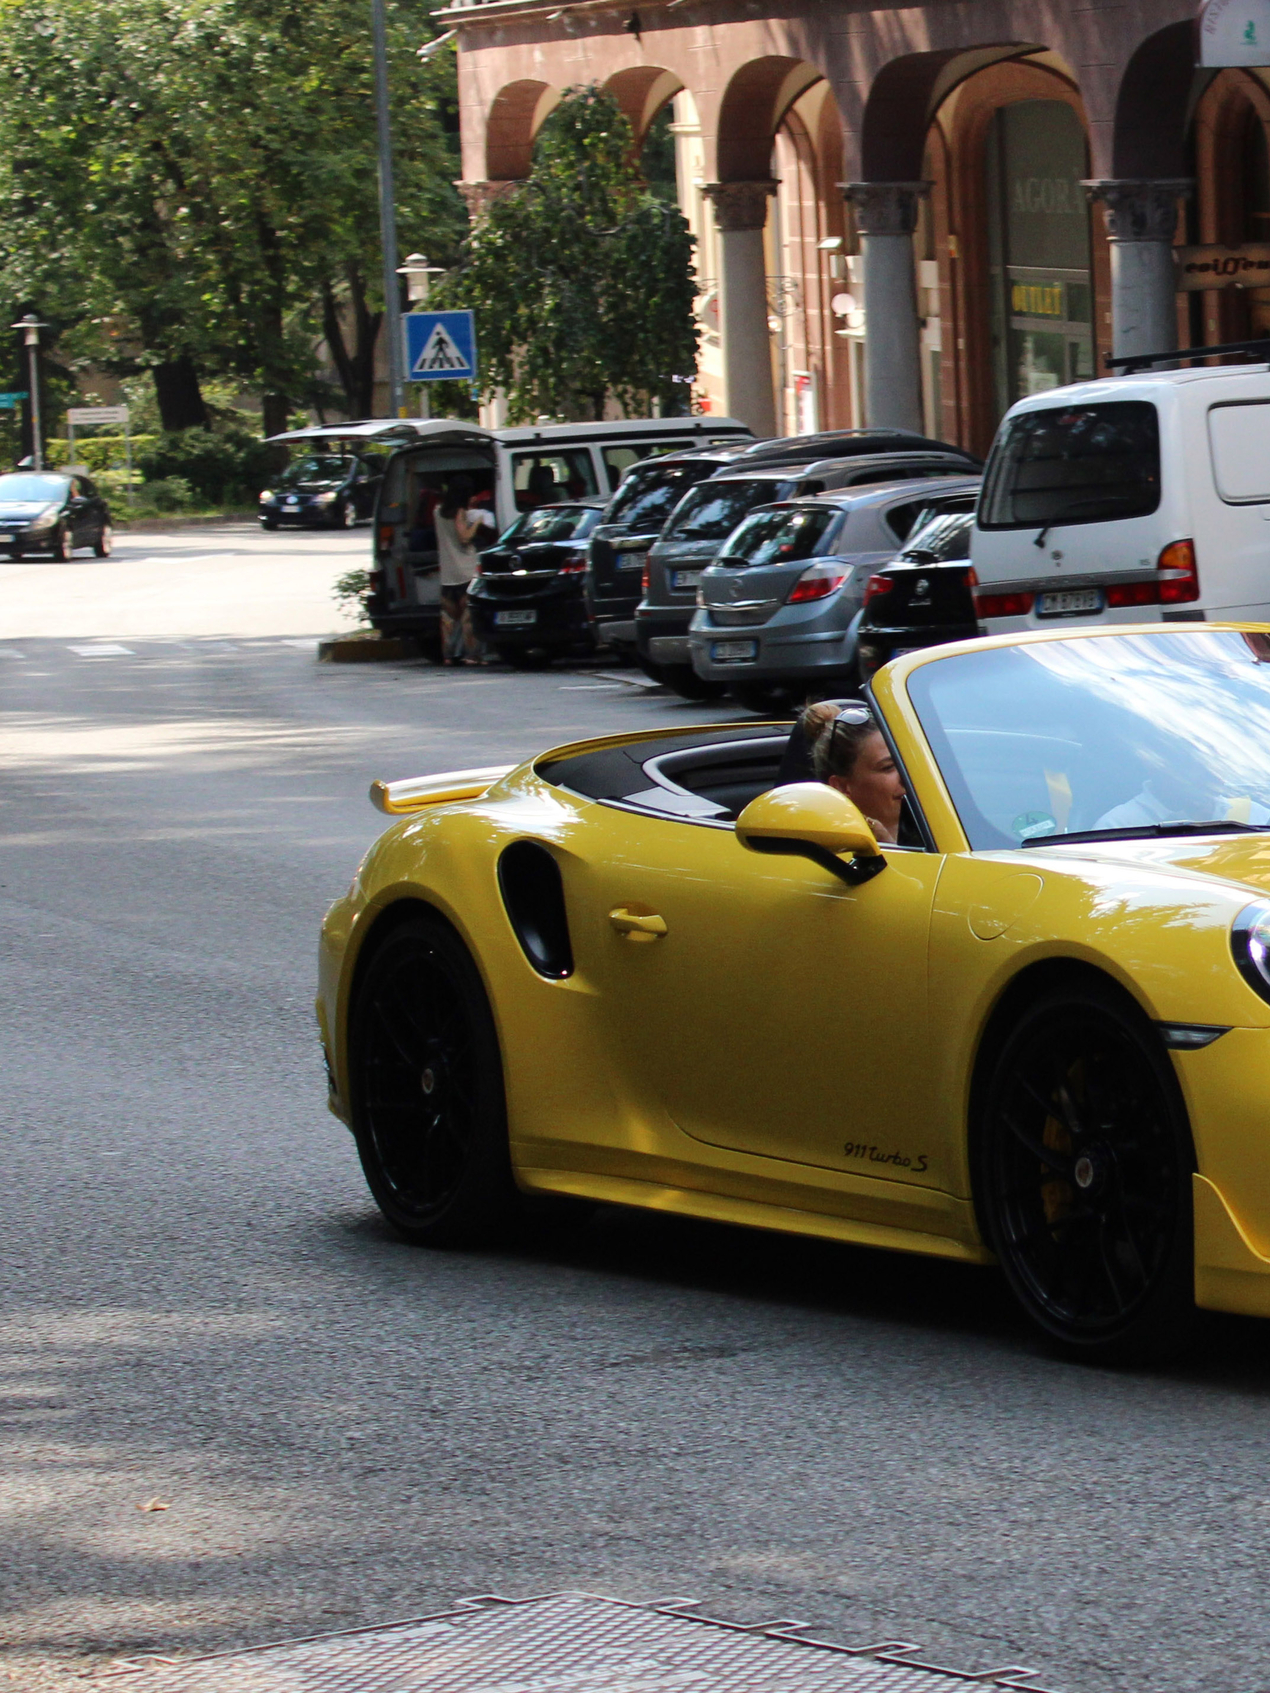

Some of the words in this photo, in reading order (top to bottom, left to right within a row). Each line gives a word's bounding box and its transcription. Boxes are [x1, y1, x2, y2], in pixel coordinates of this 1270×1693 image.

[844, 1142, 867, 1157] 911
[869, 1146, 911, 1167] Turbo
[911, 1155, 928, 1172] S
